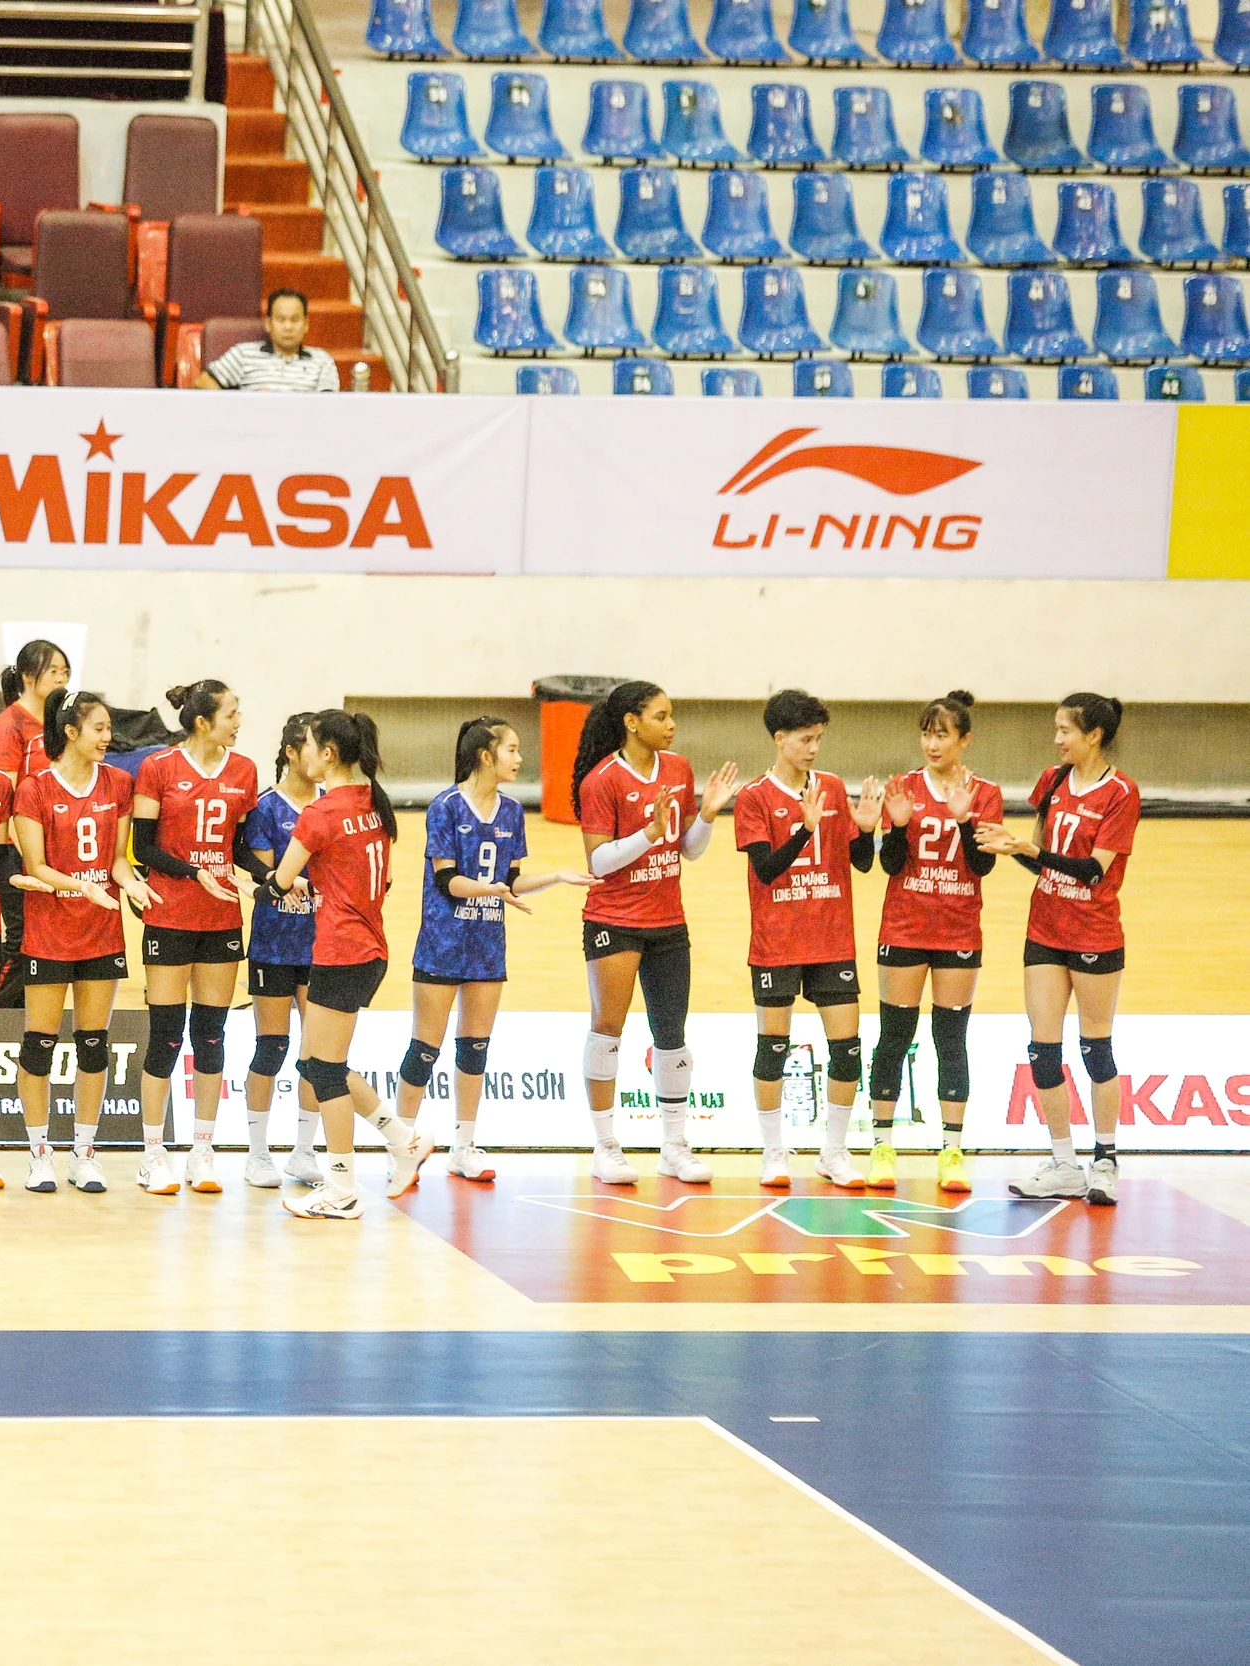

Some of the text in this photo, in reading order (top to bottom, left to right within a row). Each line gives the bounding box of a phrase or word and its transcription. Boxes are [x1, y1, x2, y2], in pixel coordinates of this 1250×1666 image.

[712, 513, 984, 551] LI-NING
[76, 817, 99, 862] 8
[195, 798, 228, 844] 12
[918, 816, 962, 862] 27
[1051, 810, 1081, 856] 17
[365, 840, 384, 901] 11
[477, 841, 498, 885] 9
[29, 960, 38, 976] 8
[147, 940, 160, 956] 12
[760, 972, 773, 989] 21
[484, 1072, 514, 1100] NG
[522, 1069, 566, 1100] SƠN
[101, 1098, 141, 1115] HAO
[517, 1195, 1072, 1239] VTV
[610, 1243, 1204, 1284] prime
